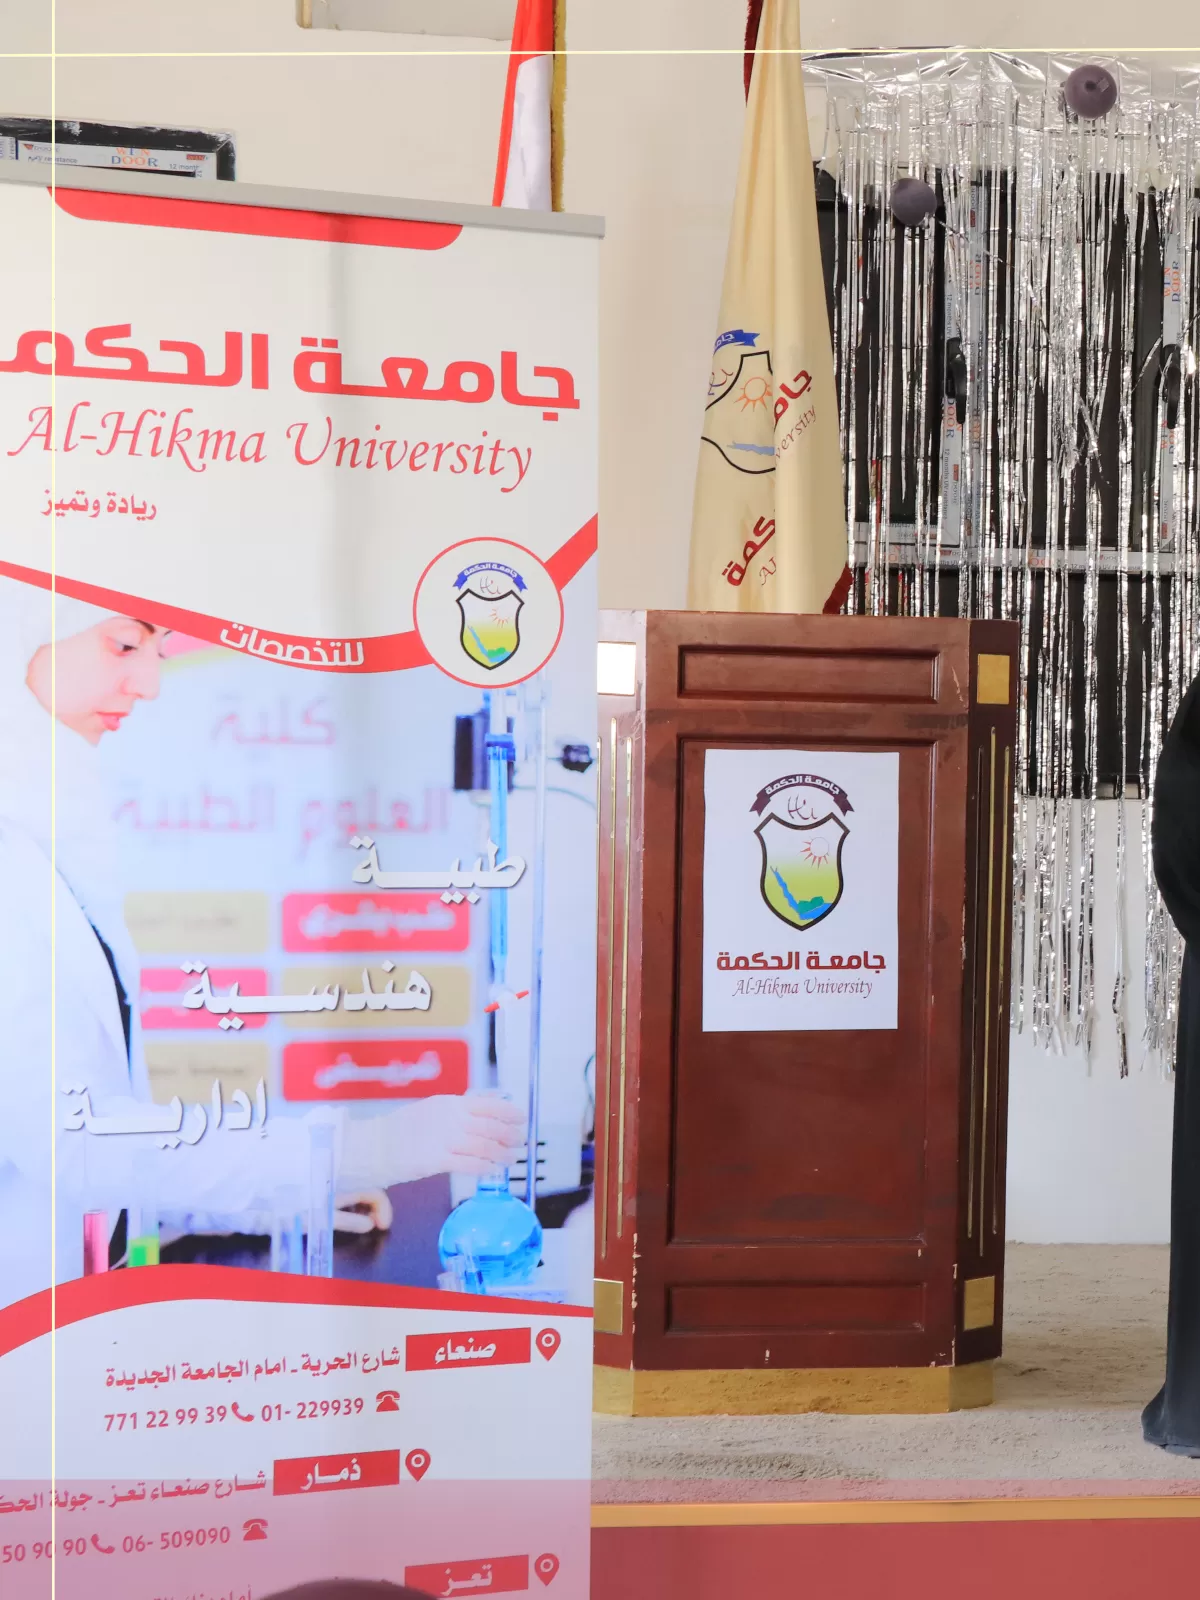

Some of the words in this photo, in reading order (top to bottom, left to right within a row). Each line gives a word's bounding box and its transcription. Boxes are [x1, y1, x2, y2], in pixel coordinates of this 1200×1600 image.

[111, 155, 158, 167] DOOR
[0, 323, 269, 390] الحكم
[293, 336, 581, 422] جامعة
[7, 401, 267, 474] Al-Hikma
[286, 417, 533, 493] University
[775, 404, 817, 463] versity
[41, 487, 101, 519] وتميز
[107, 490, 157, 520] ريادة
[220, 623, 365, 666] للتخصصات
[765, 775, 803, 795] الحكمة
[804, 775, 840, 795] جامعة
[349, 835, 527, 905] طبية
[717, 951, 800, 971] الحكمة
[806, 951, 886, 973] جامعة
[182, 959, 434, 1031] هندسية
[732, 977, 799, 998] Al-Hikma
[804, 977, 873, 999] University
[60, 1076, 269, 1150] إدارية
[301, 1351, 358, 1378] الحرية
[362, 1346, 401, 1374] شارع
[434, 1337, 497, 1365] صنعاء
[105, 1364, 176, 1391] الجديدة
[181, 1359, 249, 1384] الجامعة
[254, 1356, 286, 1381] امام
[104, 1412, 138, 1432] 771
[146, 1410, 169, 1428] 22
[175, 1408, 198, 1426] 99
[205, 1405, 227, 1423] 39
[261, 1404, 291, 1422] 01-
[296, 1398, 364, 1420] 229939
[215, 1470, 267, 1499] شارع
[301, 1458, 361, 1491] ذمار
[0, 1492, 43, 1514] الحك
[51, 1488, 93, 1512] جولة
[109, 1482, 146, 1508] تعز
[150, 1477, 209, 1502] صنعاء
[2, 1544, 26, 1563] 50
[32, 1541, 55, 1560] 90
[63, 1537, 87, 1557] 90
[122, 1534, 153, 1554] 06-
[160, 1526, 230, 1550] 509090
[440, 1563, 493, 1597] تعز
